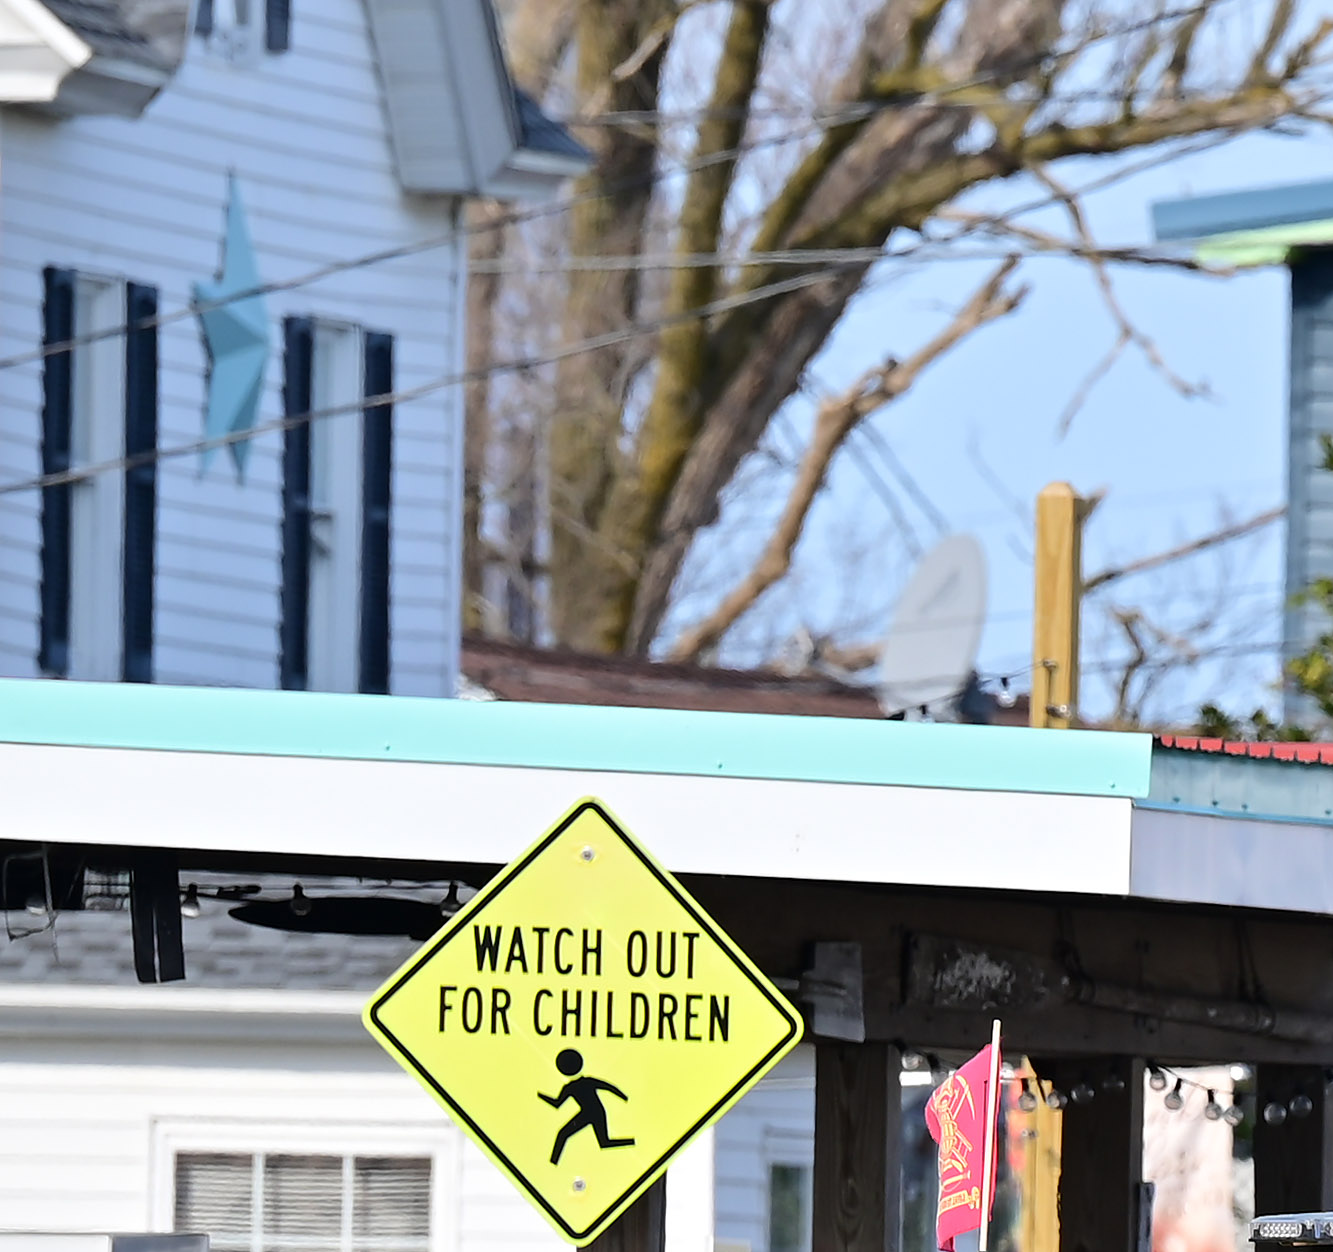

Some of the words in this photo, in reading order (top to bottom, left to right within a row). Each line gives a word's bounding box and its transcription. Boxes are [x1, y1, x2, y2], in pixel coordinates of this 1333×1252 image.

[473, 924, 603, 976] WATCH
[626, 930, 700, 980] OUT
[438, 985, 512, 1035] FOR
[533, 988, 731, 1043] CHILDREN
